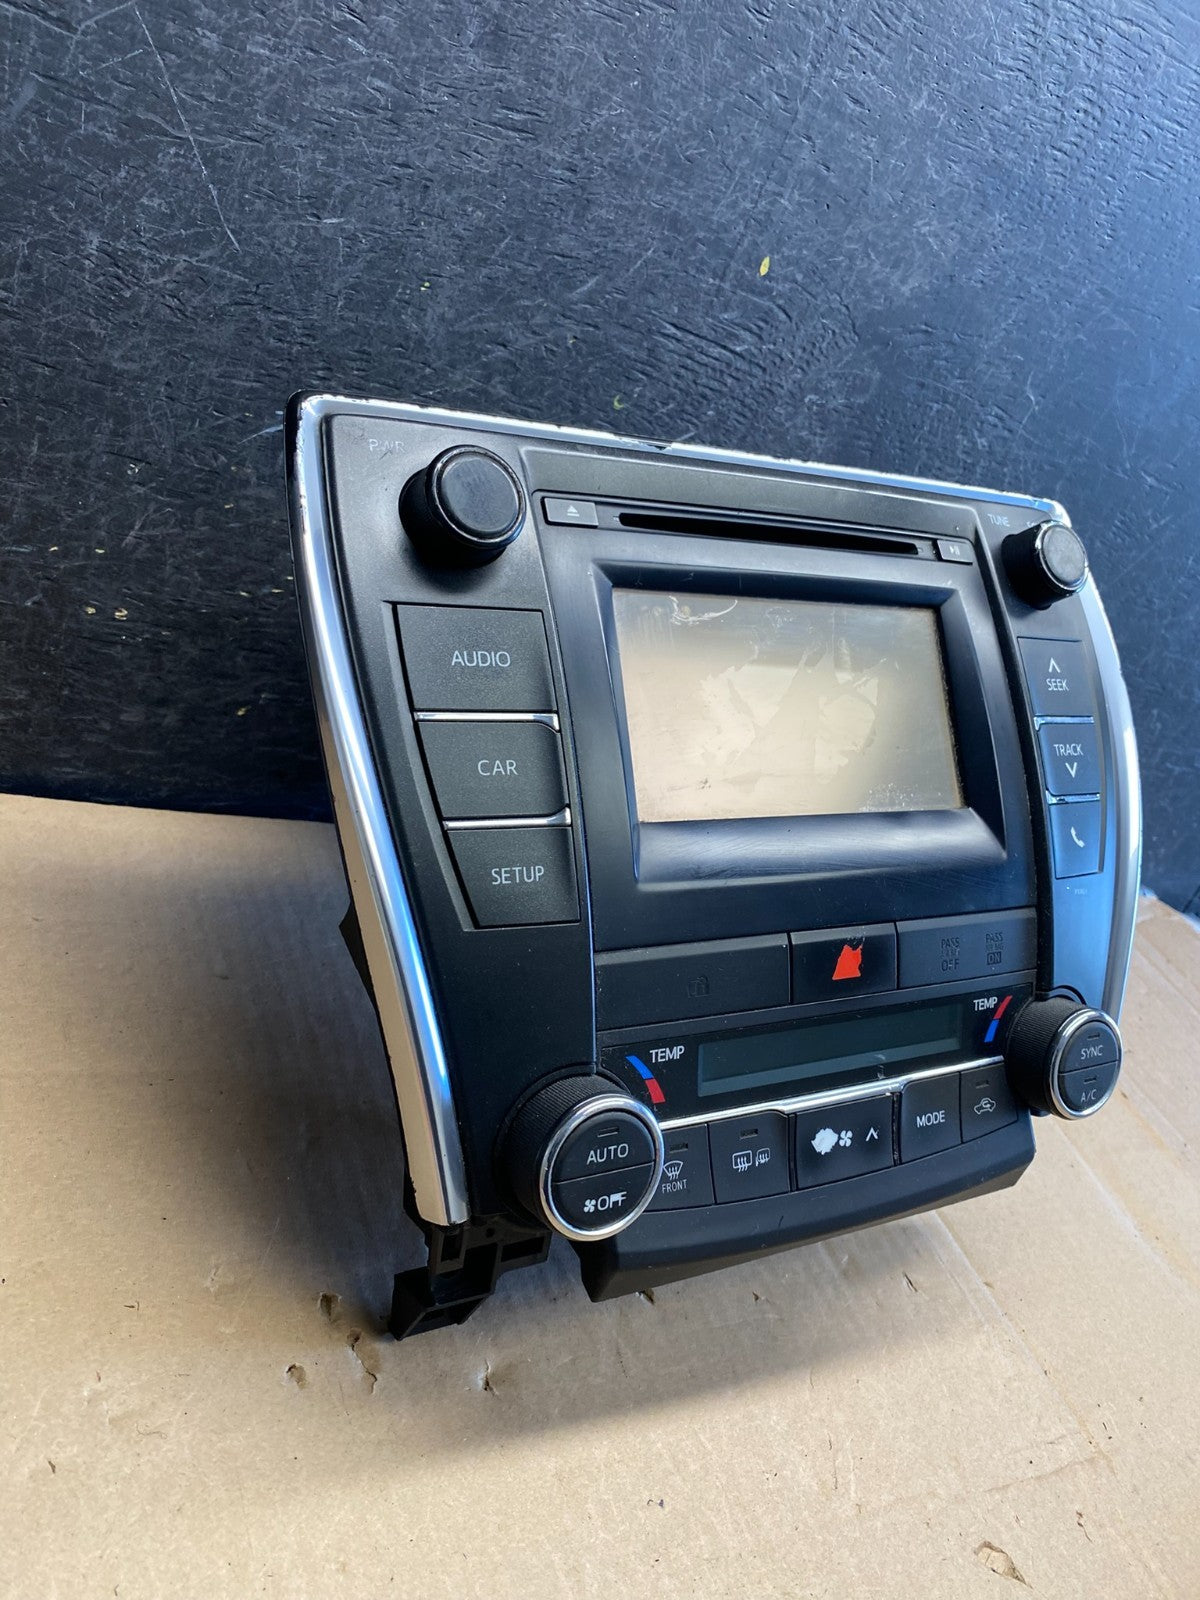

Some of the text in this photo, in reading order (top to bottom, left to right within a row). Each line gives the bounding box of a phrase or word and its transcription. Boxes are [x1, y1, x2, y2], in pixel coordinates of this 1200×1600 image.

[987, 513, 1010, 527] TUNE
[451, 651, 511, 667] AUDIO
[1046, 678, 1069, 691] SEEK
[1053, 743, 1084, 756] TRACK
[477, 759, 518, 776] CAR
[491, 865, 545, 885] SETUP
[941, 937, 960, 949] PASS
[985, 932, 1004, 943] PASS
[941, 958, 960, 972] OFF
[986, 951, 1002, 966] ON
[973, 996, 998, 1011] TEMP
[650, 1045, 685, 1063] TEMP
[1080, 1045, 1104, 1060] SYNC
[1080, 1089, 1098, 1102] A/C
[916, 1110, 946, 1128] MODE
[586, 1143, 629, 1165] AUTO
[661, 1180, 688, 1194] FRONT
[597, 1191, 627, 1211] OFF
